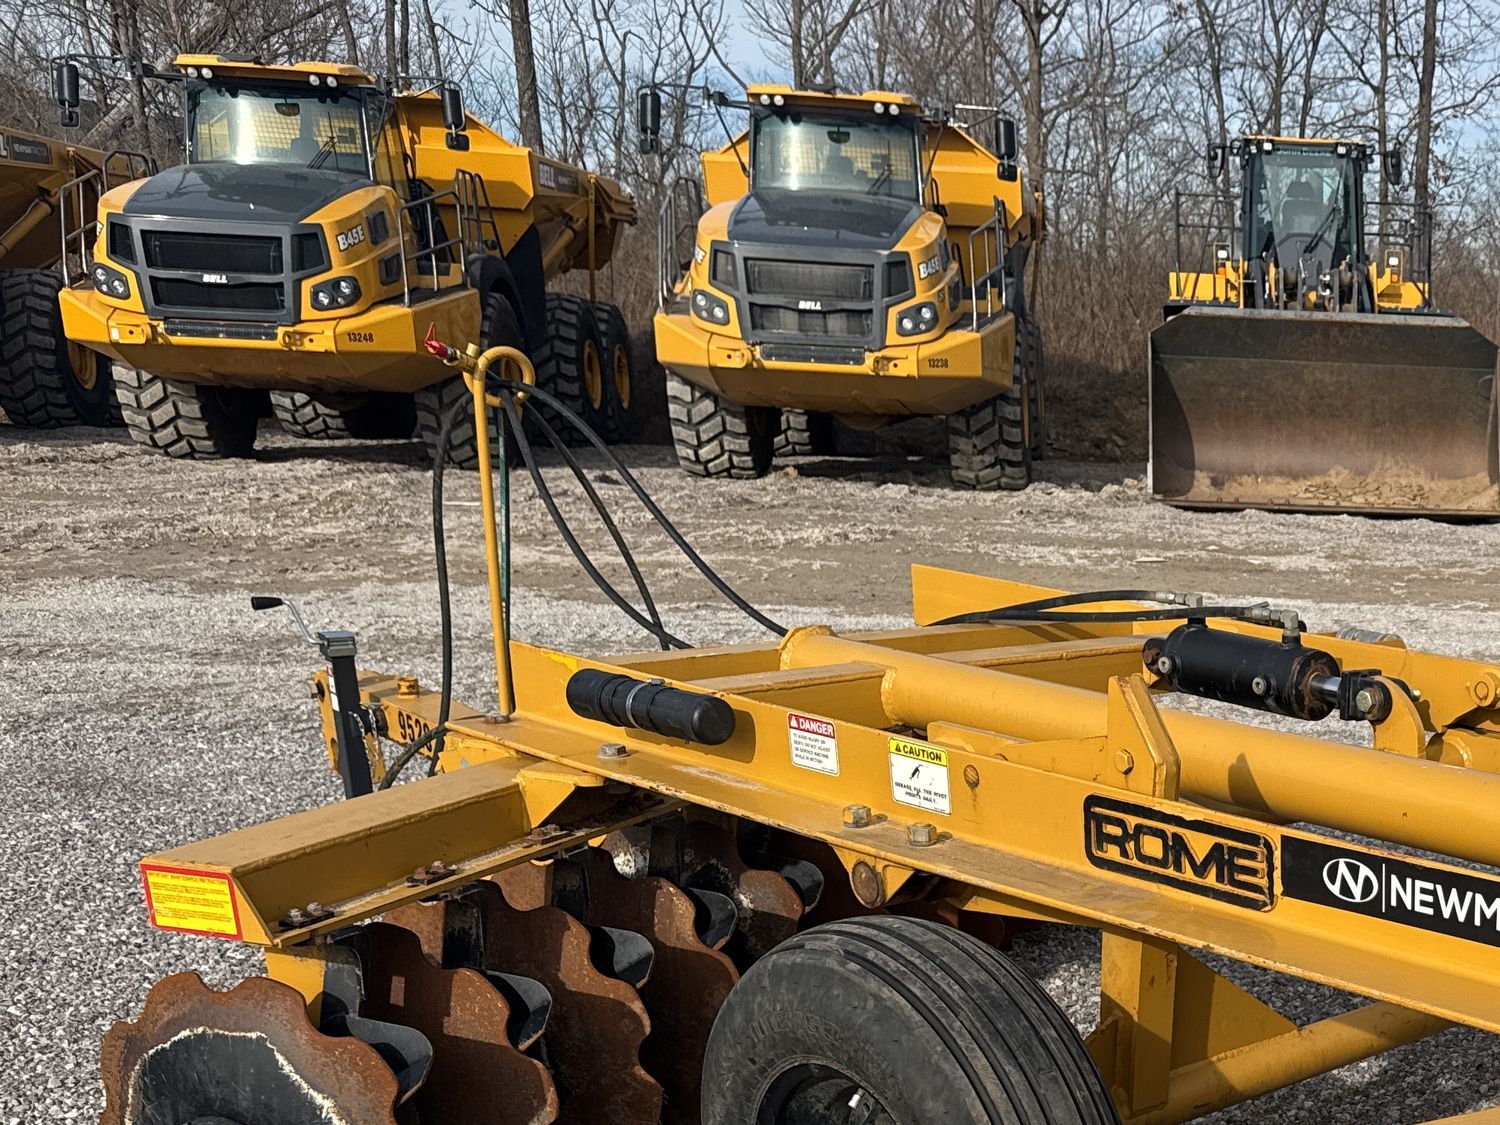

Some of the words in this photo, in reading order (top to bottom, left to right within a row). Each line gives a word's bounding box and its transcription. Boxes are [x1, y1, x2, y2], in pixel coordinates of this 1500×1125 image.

[337, 226, 365, 251] B45E
[202, 273, 228, 284] BELL
[797, 299, 822, 310] BELL
[346, 332, 375, 343] 13248
[799, 718, 834, 738] DANGER
[902, 744, 942, 762] CAUTION
[1093, 813, 1267, 896] ROME
